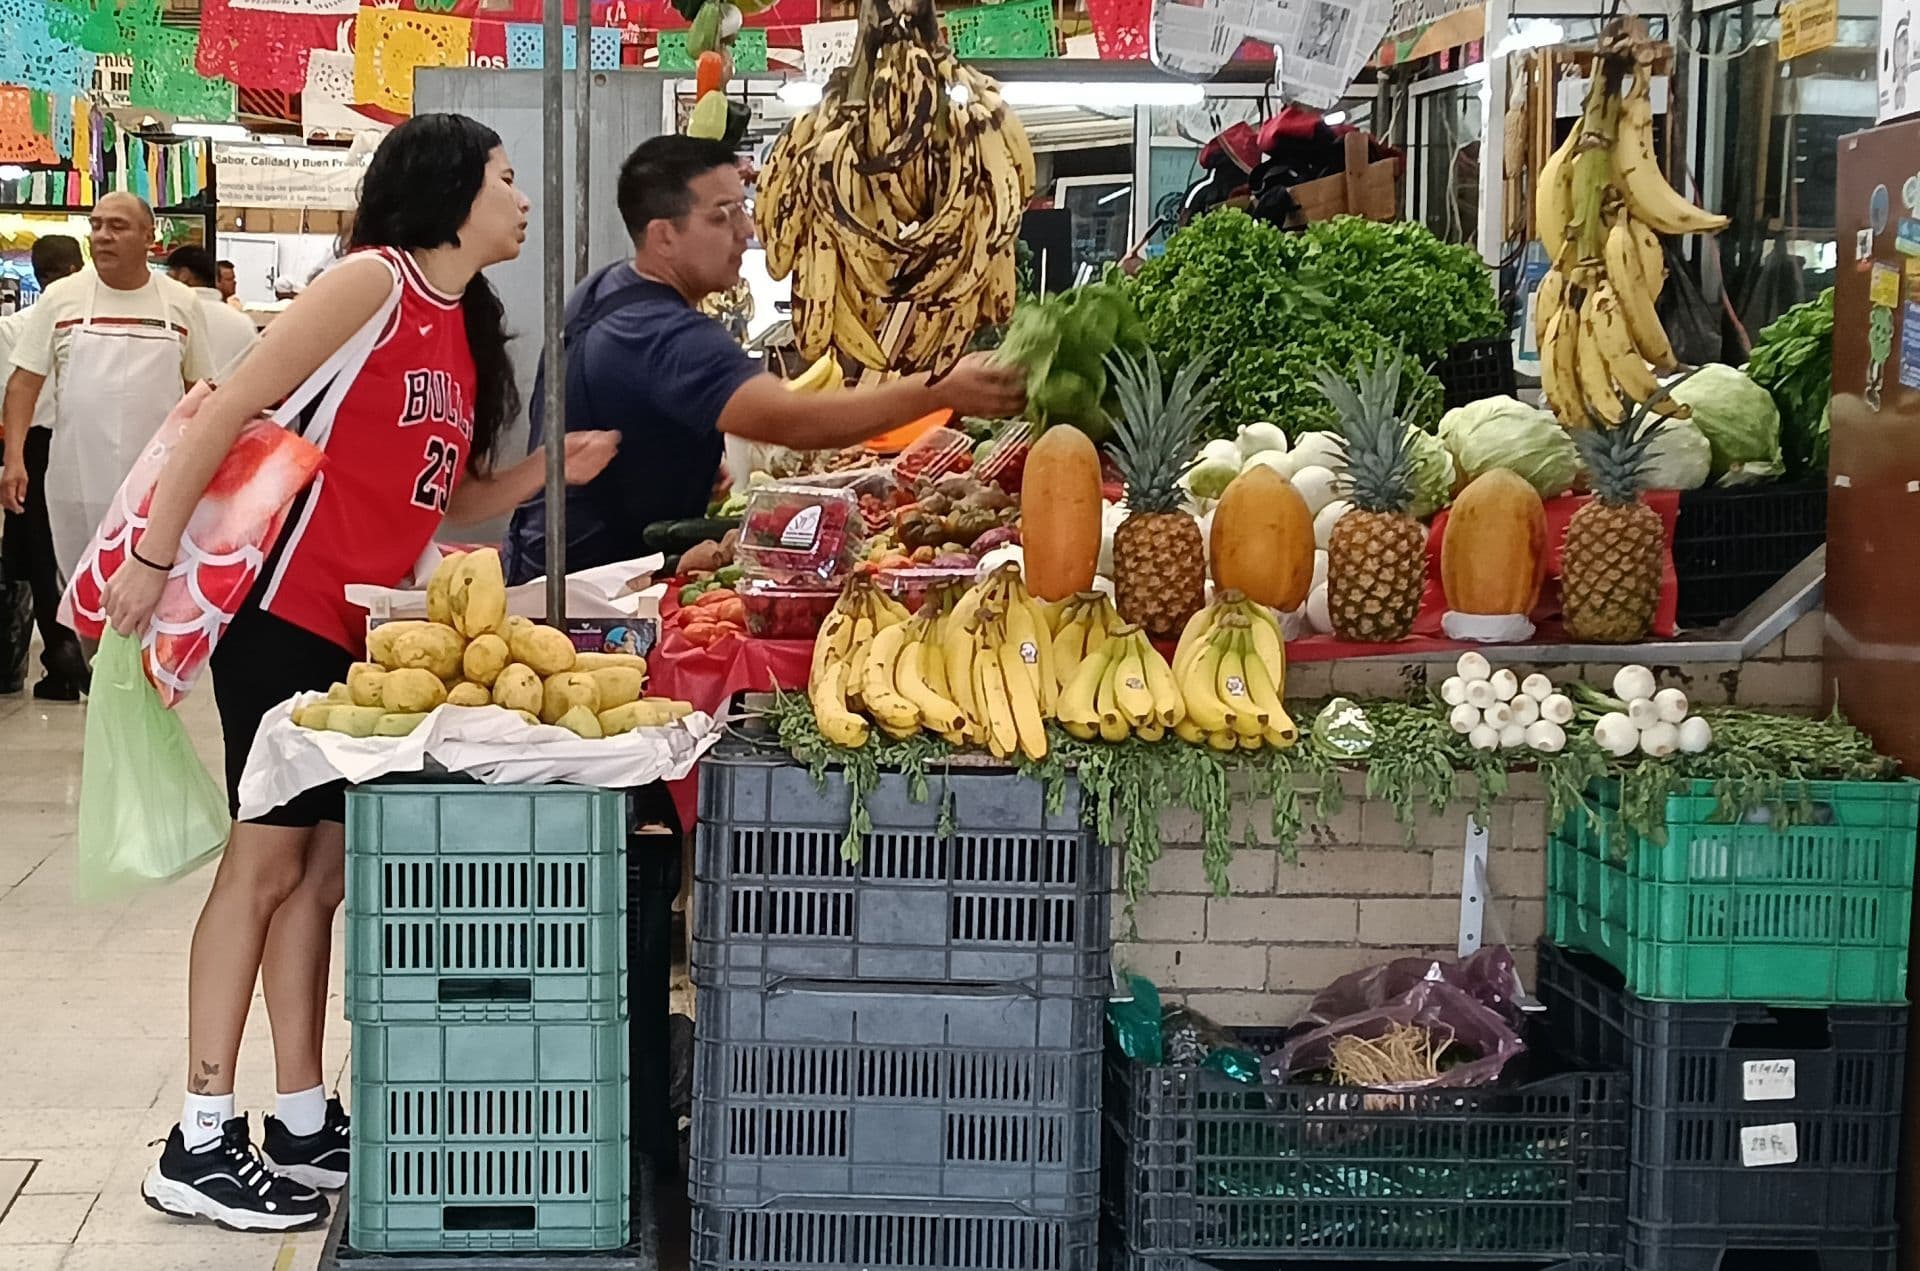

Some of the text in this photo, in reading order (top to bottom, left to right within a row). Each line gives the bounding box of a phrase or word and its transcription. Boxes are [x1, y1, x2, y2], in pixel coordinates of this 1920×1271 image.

[215, 156, 248, 166] Sabor,
[251, 156, 290, 167] Calidad
[293, 159, 299, 169] y
[302, 158, 329, 168] Buen
[410, 435, 459, 515] 23
